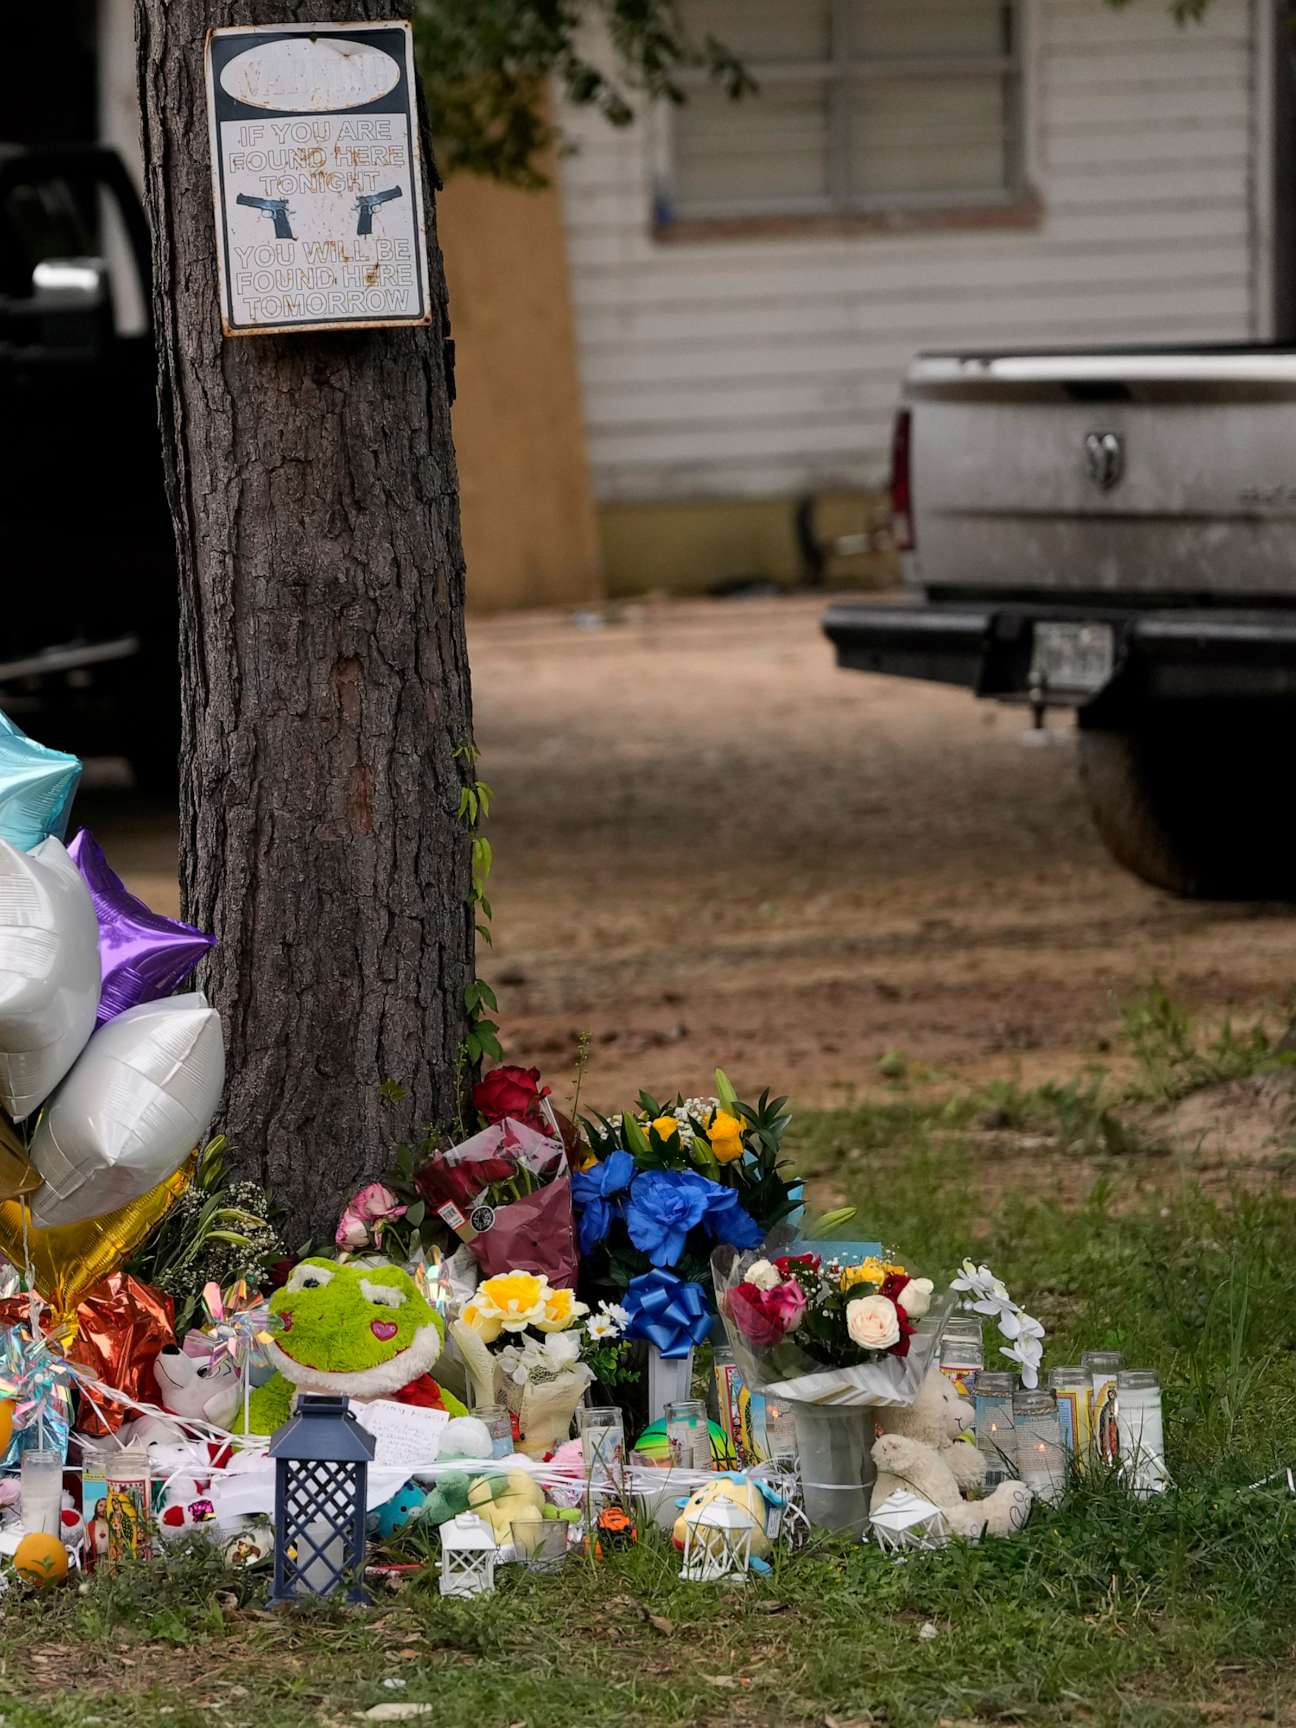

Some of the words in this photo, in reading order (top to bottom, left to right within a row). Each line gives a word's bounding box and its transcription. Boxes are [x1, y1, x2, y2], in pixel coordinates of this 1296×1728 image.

[240, 125, 264, 147] IF
[271, 120, 331, 144] YOU
[338, 119, 392, 141] ARE
[229, 147, 327, 173] FOUND
[335, 144, 405, 168] HERE
[259, 170, 380, 196] TONIGHT
[234, 242, 295, 269] YOU
[303, 239, 370, 264] WILL
[376, 238, 411, 262] BE
[236, 266, 335, 295] FOUND
[342, 264, 413, 288] HERE
[242, 289, 410, 320] TOMORROW
